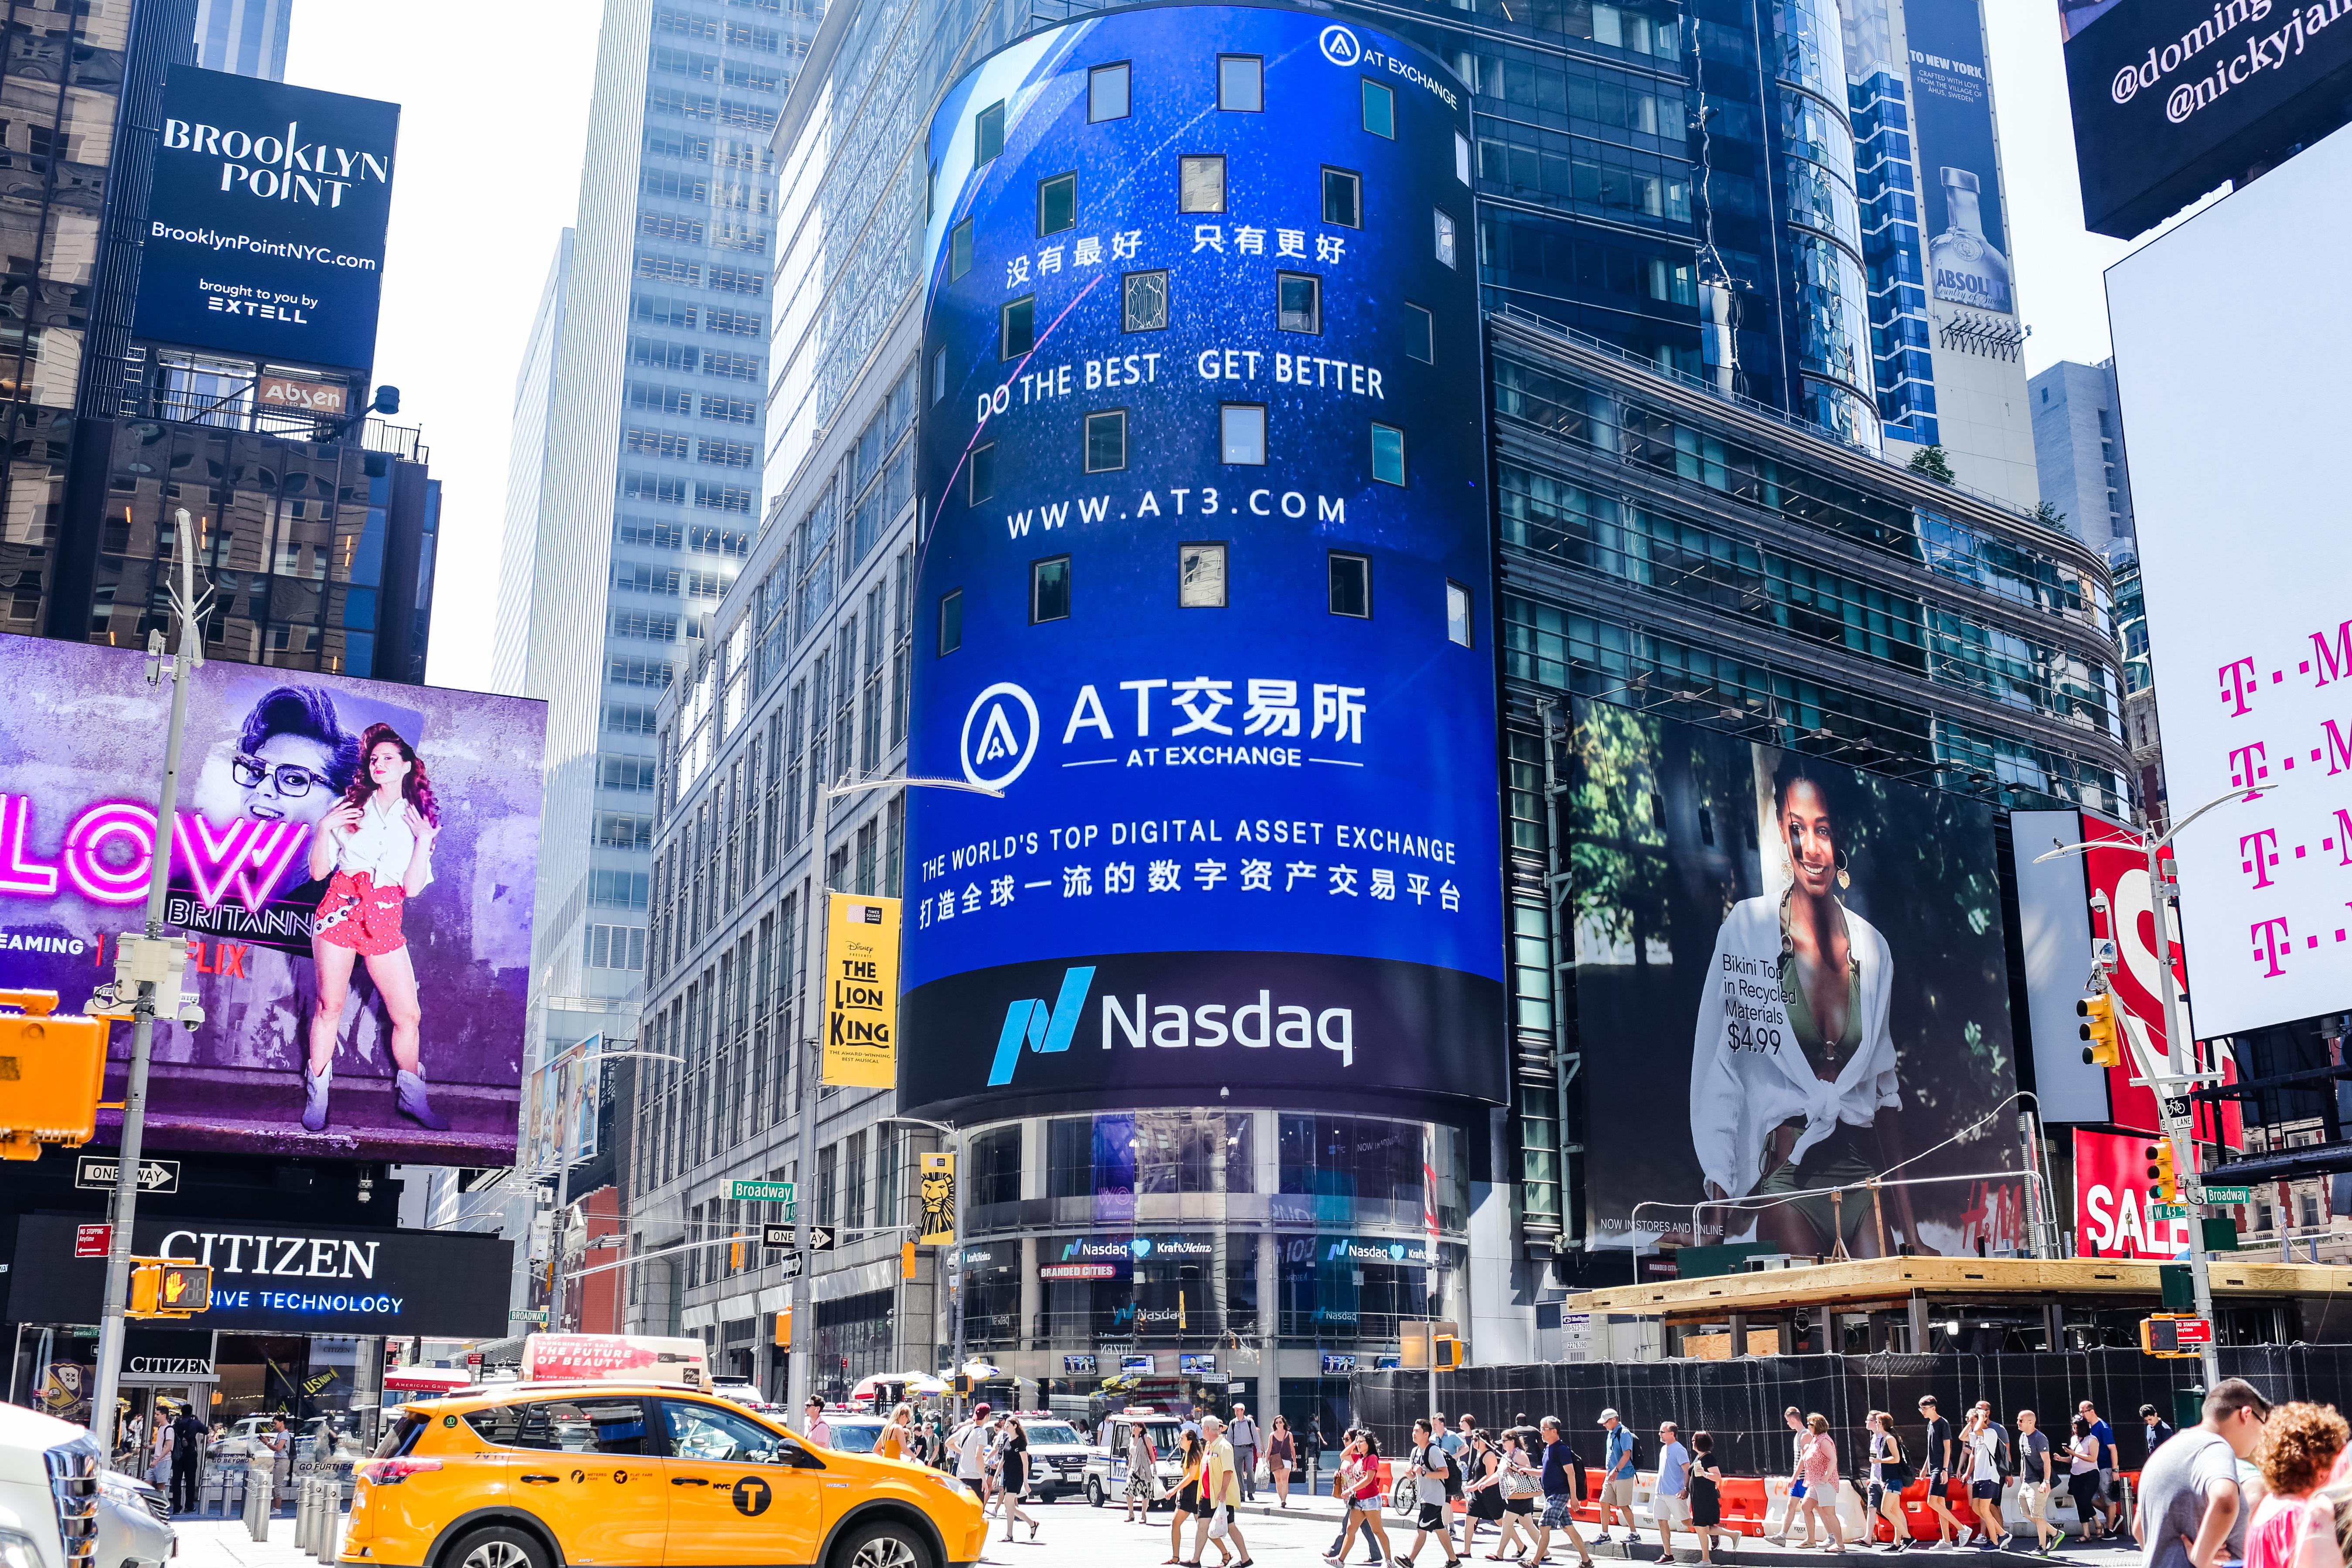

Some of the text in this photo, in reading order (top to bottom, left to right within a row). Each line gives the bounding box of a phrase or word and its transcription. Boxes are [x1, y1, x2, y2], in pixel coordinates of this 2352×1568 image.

[1909, 49, 1985, 80] TO NEW YORK,
[1364, 49, 1457, 111] AT EXCHANGE
[1917, 77, 1935, 86] FROM
[1948, 85, 1972, 95] VILLAGE
[1919, 69, 1979, 90] CRAFTED WITH LOVE
[1948, 92, 1974, 102] SWEDEN
[164, 118, 388, 184] BROOKLYN
[221, 162, 352, 208] POINT
[152, 222, 376, 271] BrooklynPointNYC.com
[1006, 225, 1346, 290] 没有最好 只有更好
[200, 279, 318, 309] brought to you by
[208, 296, 307, 324] EXTELL
[265, 383, 341, 408] Absen
[977, 350, 1384, 423] DO THE BEST GET BETTER
[1007, 488, 1346, 539] WWW.AT3.COM
[1126, 747, 1302, 767] AT EXCHANGE
[921, 819, 1457, 883] THE WORLD'S TOP DIGITAL ASSET EXCHANGE
[920, 859, 1461, 930] 打造全球一流的数字资产交易平台
[845, 941, 873, 954] Disney
[842, 960, 876, 978] THE
[1723, 954, 1785, 984] Bikini Top
[1724, 977, 1797, 1005] in Recycled
[1725, 999, 1783, 1025] Materials
[1102, 989, 1353, 1067] Nasdaq
[1728, 1021, 1781, 1055] $4.99
[2177, 1117, 2191, 1126] LANE
[93, 1167, 118, 1179] ONE
[736, 1183, 791, 1202] Broadway
[2208, 1189, 2246, 1203] Broadway
[1960, 1181, 2021, 1253] H&M
[2154, 1207, 2162, 1218] W
[2166, 1206, 2176, 1217] 43
[774, 1231, 824, 1243] ONE AY
[1601, 1219, 1724, 1236] NOW IN STORES AND NLINE
[160, 1231, 380, 1279] CITIZEN
[1083, 1243, 1127, 1257] Nasdaq
[1349, 1245, 1388, 1260] Nasdaq
[1041, 1266, 1113, 1277] BRANDED CITIES
[208, 1291, 403, 1313] RIVE TECHNOLOGY
[511, 1311, 545, 1321] BROADWAY
[1137, 1308, 1186, 1321] Nasdaq
[1326, 1311, 1357, 1322] Nasdaq
[1563, 1323, 1591, 1332] 800-523-7918
[538, 1346, 633, 1358] THE FUTURE
[562, 1357, 624, 1367] BEAUTY
[130, 1357, 213, 1374] CITIZEN
[1113, 1466, 1128, 1477] NYPD
[741, 1484, 763, 1512] T
